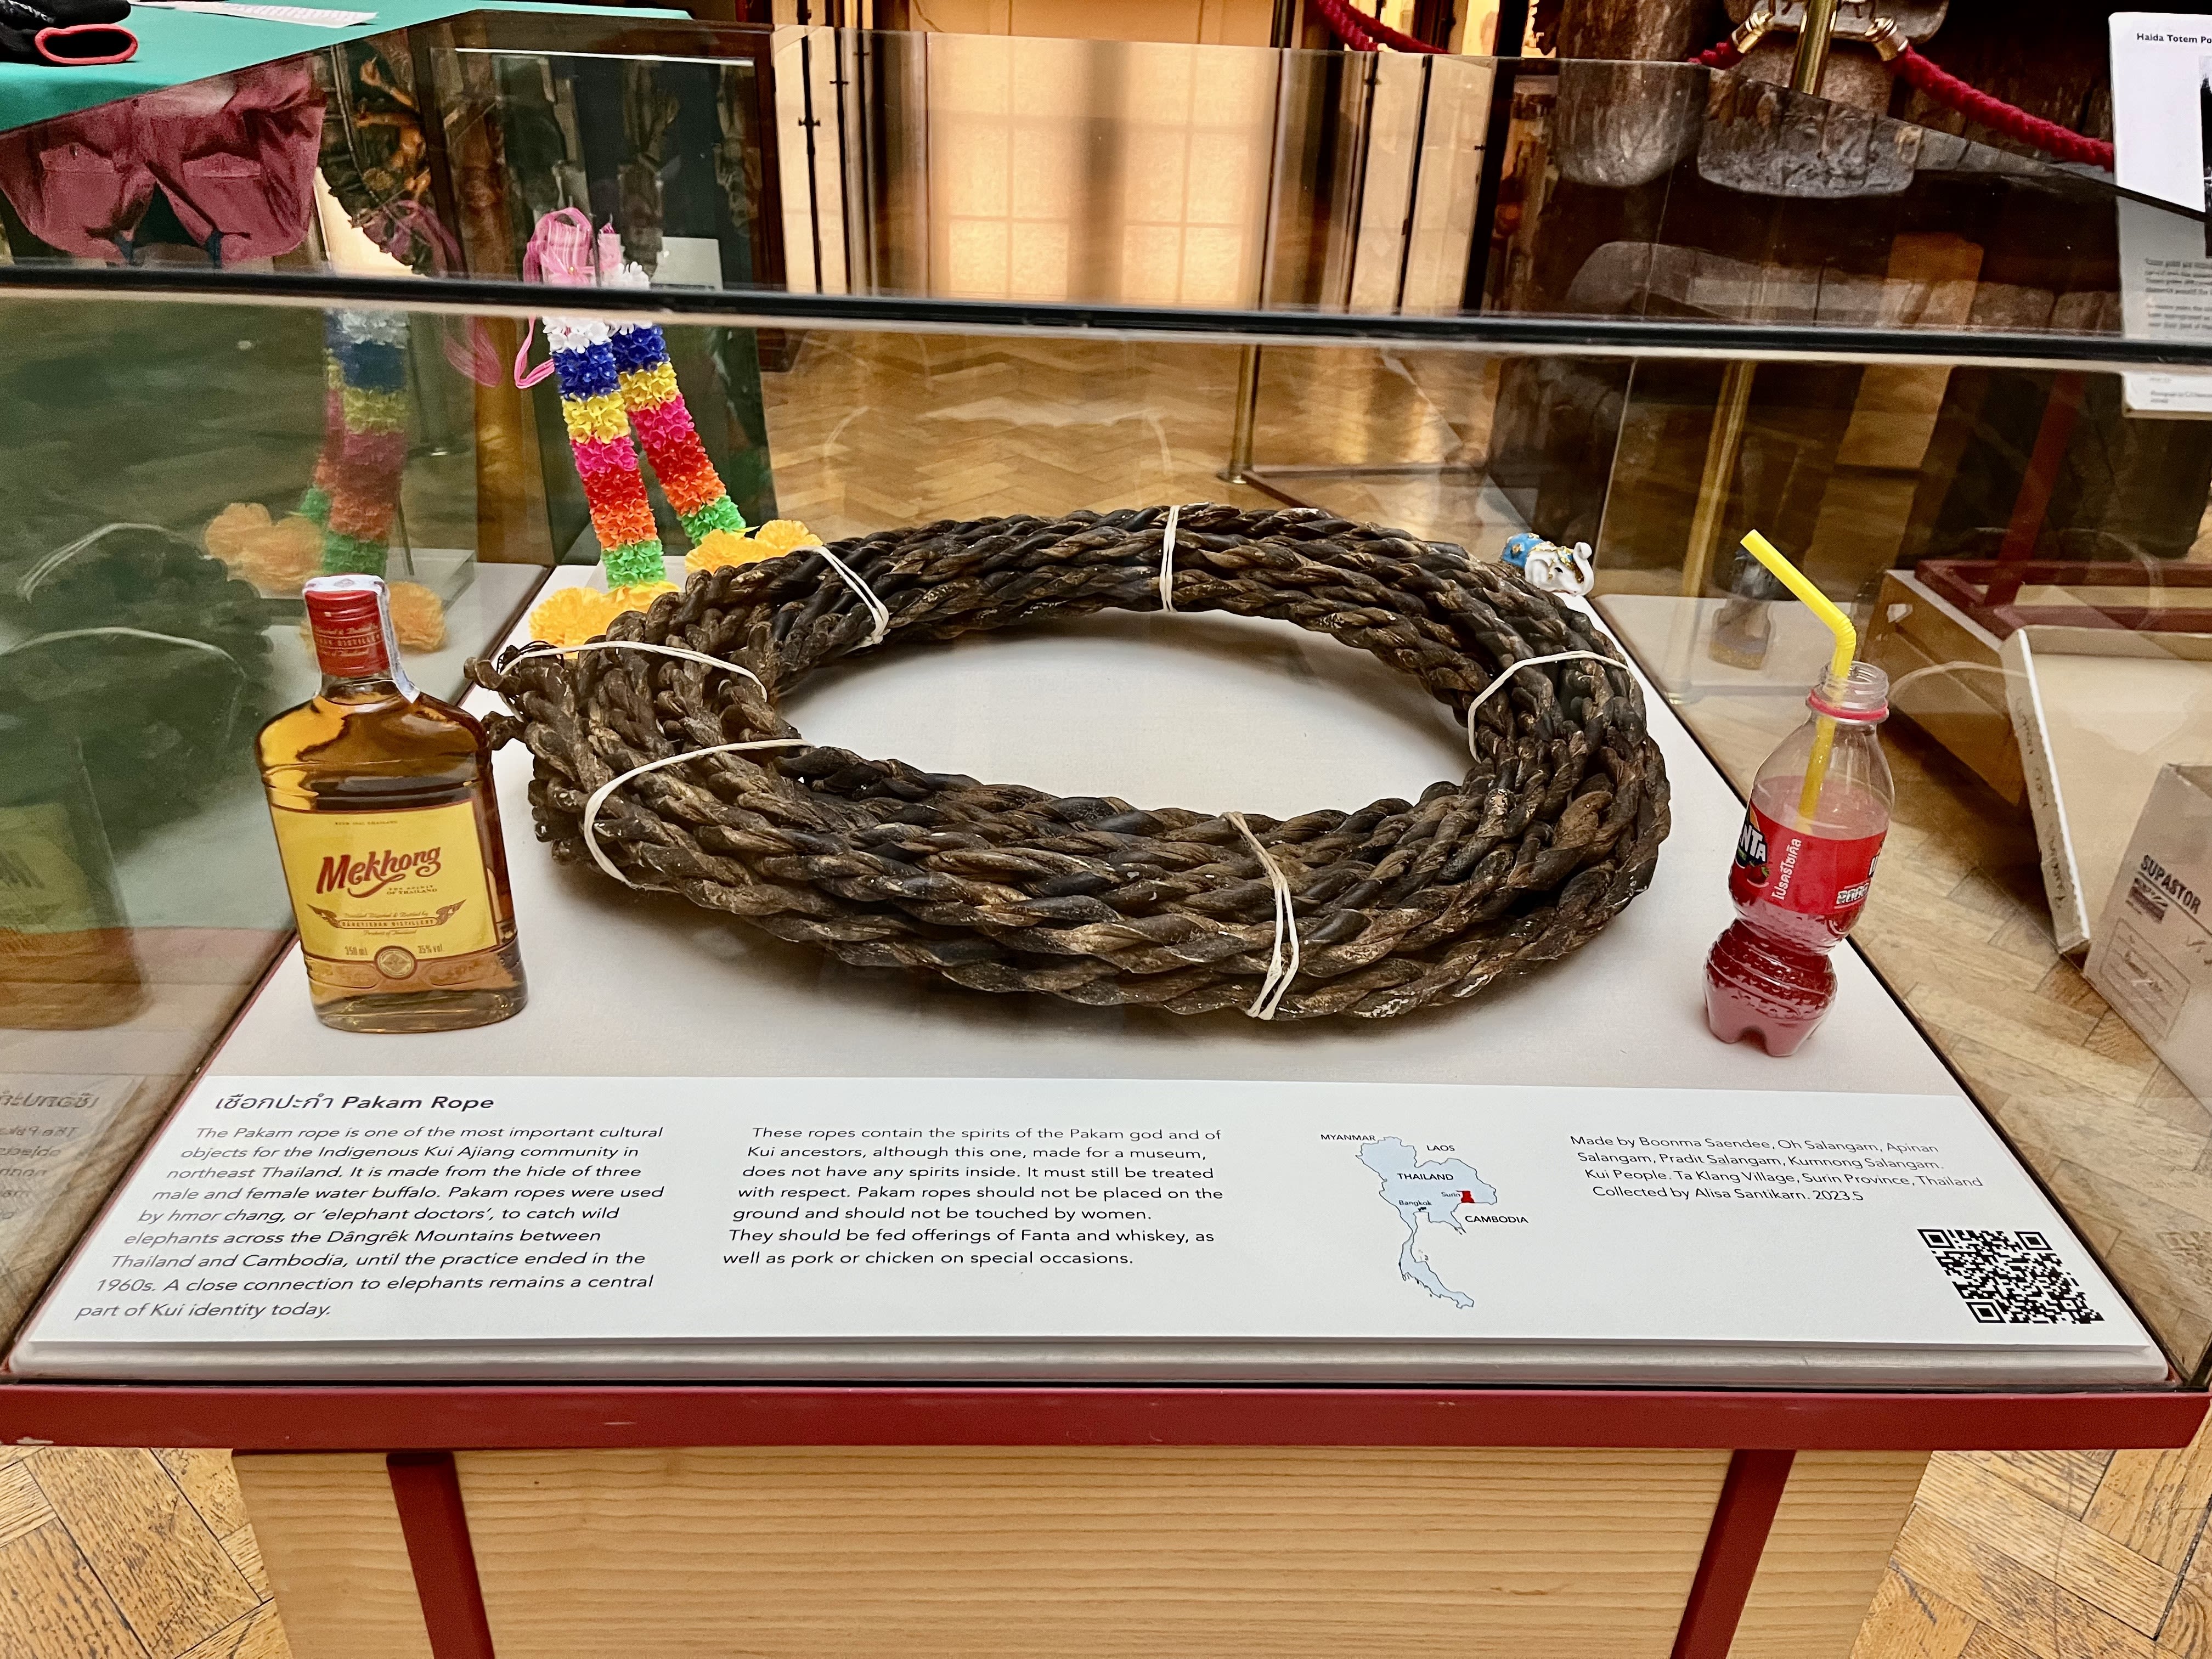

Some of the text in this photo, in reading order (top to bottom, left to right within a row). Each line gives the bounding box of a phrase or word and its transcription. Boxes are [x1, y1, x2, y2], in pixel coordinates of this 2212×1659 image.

[2137, 33, 2164, 42] Haida
[2167, 34, 2198, 43] Totem
[1740, 824, 1766, 862] NTA
[316, 847, 441, 899] Mekhong
[2141, 854, 2202, 915] SUPASTOR
[341, 1095, 494, 1112] Pakam Rope
[197, 1127, 228, 1138] The
[233, 1127, 293, 1138] Pakam
[297, 1130, 340, 1141] rope
[345, 1127, 359, 1137] is
[404, 1126, 426, 1137] of
[427, 1126, 455, 1137] the
[460, 1128, 505, 1137] most
[509, 1127, 595, 1141] important
[600, 1126, 663, 1137] cultural
[753, 1127, 1221, 1142] These ropes contain the spirits of the Pakam god and of
[180, 1146, 639, 1161] objects for the Indigenous Kui Ajiang community in
[747, 1146, 775, 1157] Kui
[780, 1148, 866, 1159] ancestors,
[873, 1146, 948, 1160] although
[954, 1146, 984, 1157] this
[990, 1149, 1026, 1159] one,
[1033, 1147, 1080, 1158] made
[1086, 1147, 1110, 1158] for
[1130, 1150, 1206, 1160] museum,
[1570, 1136, 1939, 1154] Made by Boonma Saendee, Oh Salangam, Apinan
[1577, 1152, 1944, 1171] Salangam, Pradit Salangam, Kumnong Salangam.
[1397, 1172, 1454, 1181] THAILAND
[1584, 1169, 1984, 1187] Kui People. Ta Klang Village, Surin Province, Thailand
[738, 1186, 774, 1198] with
[781, 1188, 850, 1201] respect.
[858, 1186, 915, 1198] Pakam
[922, 1189, 970, 1201] ropes
[977, 1186, 1034, 1198] should
[1041, 1189, 1070, 1198] not
[1075, 1186, 1097, 1198] be
[1104, 1187, 1161, 1202] placed
[1194, 1187, 1223, 1199] the
[1593, 1186, 1864, 1201] Collected by Alisa Santikarn. 2023.5
[137, 1209, 165, 1225] by
[166, 1209, 223, 1222] hmor
[224, 1209, 285, 1224] chang,
[294, 1212, 316, 1221] or
[502, 1209, 521, 1219] to
[527, 1206, 575, 1219] catch
[582, 1206, 620, 1219] wild
[1465, 1215, 1529, 1224] CAMBODIA
[123, 1228, 601, 1249] elephants across the Dângrêk Mountains between
[729, 1228, 1214, 1245] They should be fed offerings of Fanta and whiskey, as
[723, 1250, 1133, 1268] well as pork or chicken on special occasions.
[97, 1274, 654, 1294] 1960s. A close connection to elephants remains a central
[74, 1301, 331, 1321] part of Kui identity today.
